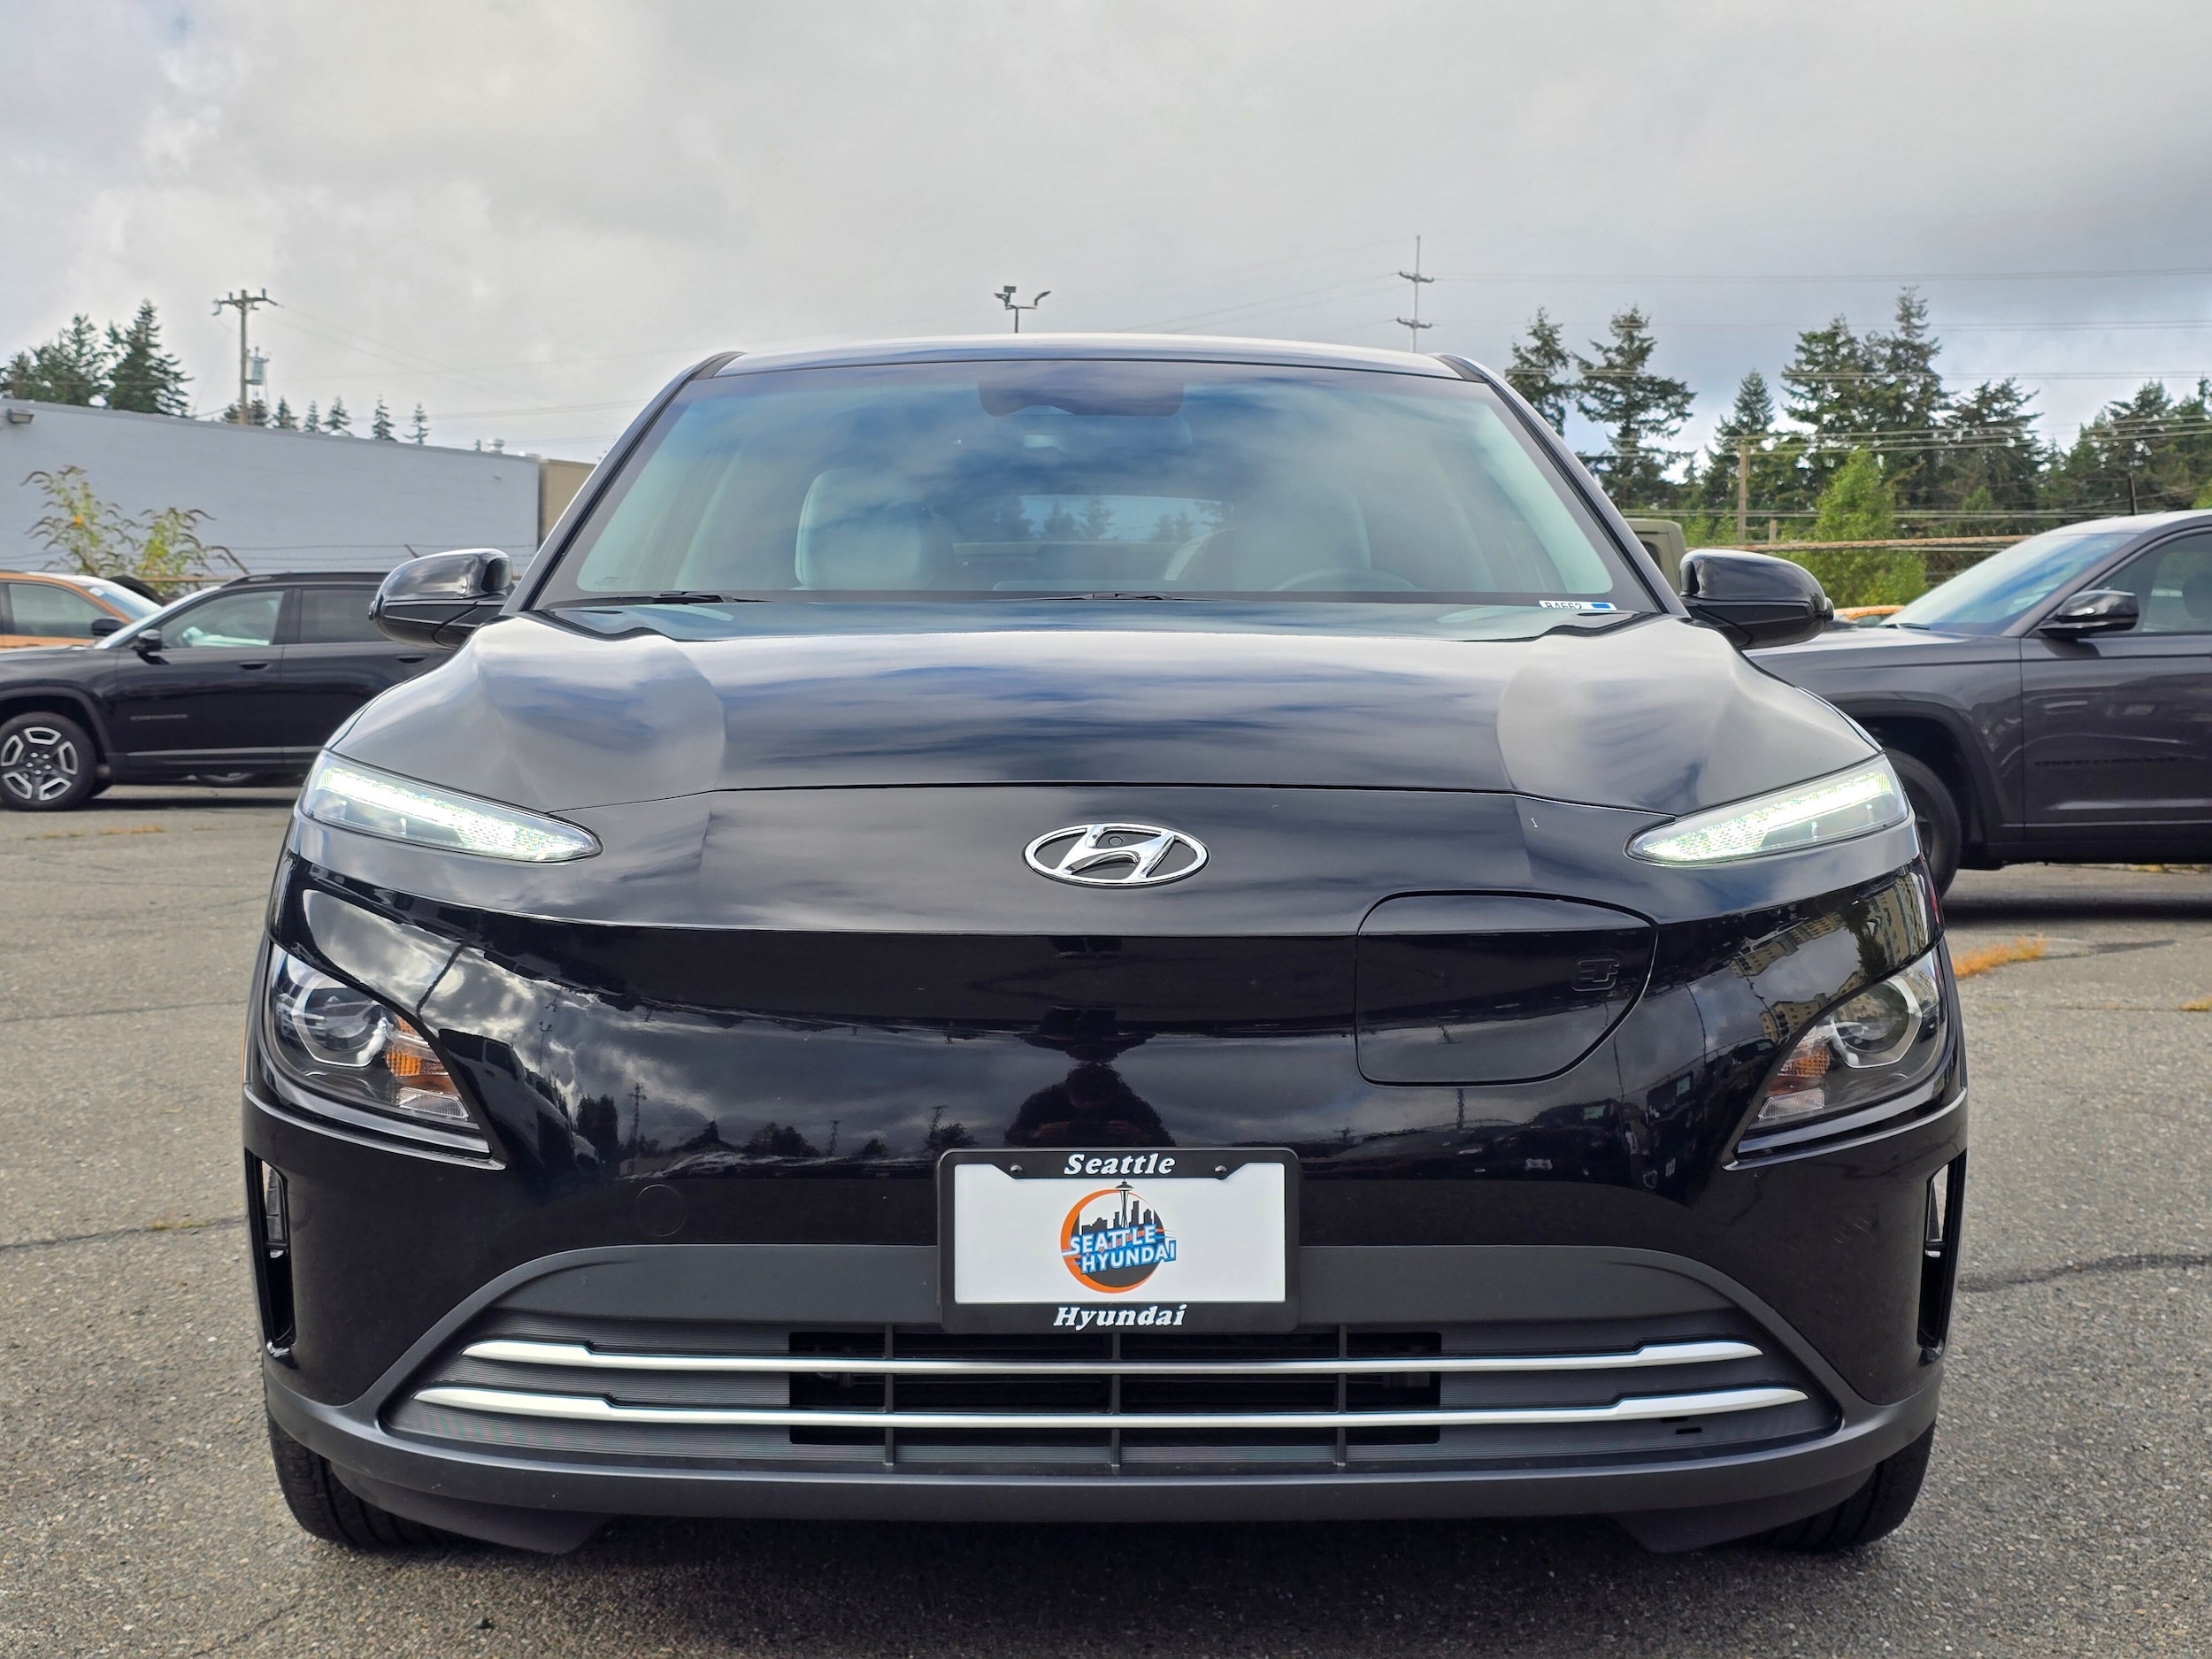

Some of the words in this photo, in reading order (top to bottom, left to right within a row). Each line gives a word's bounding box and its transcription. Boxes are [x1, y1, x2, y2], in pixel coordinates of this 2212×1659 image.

[1064, 1153, 1176, 1175] Seattle
[1070, 1225, 1156, 1255] SEATTLE
[1082, 1240, 1176, 1273] HYUNDAI
[1053, 1305, 1187, 1331] Hyundai
